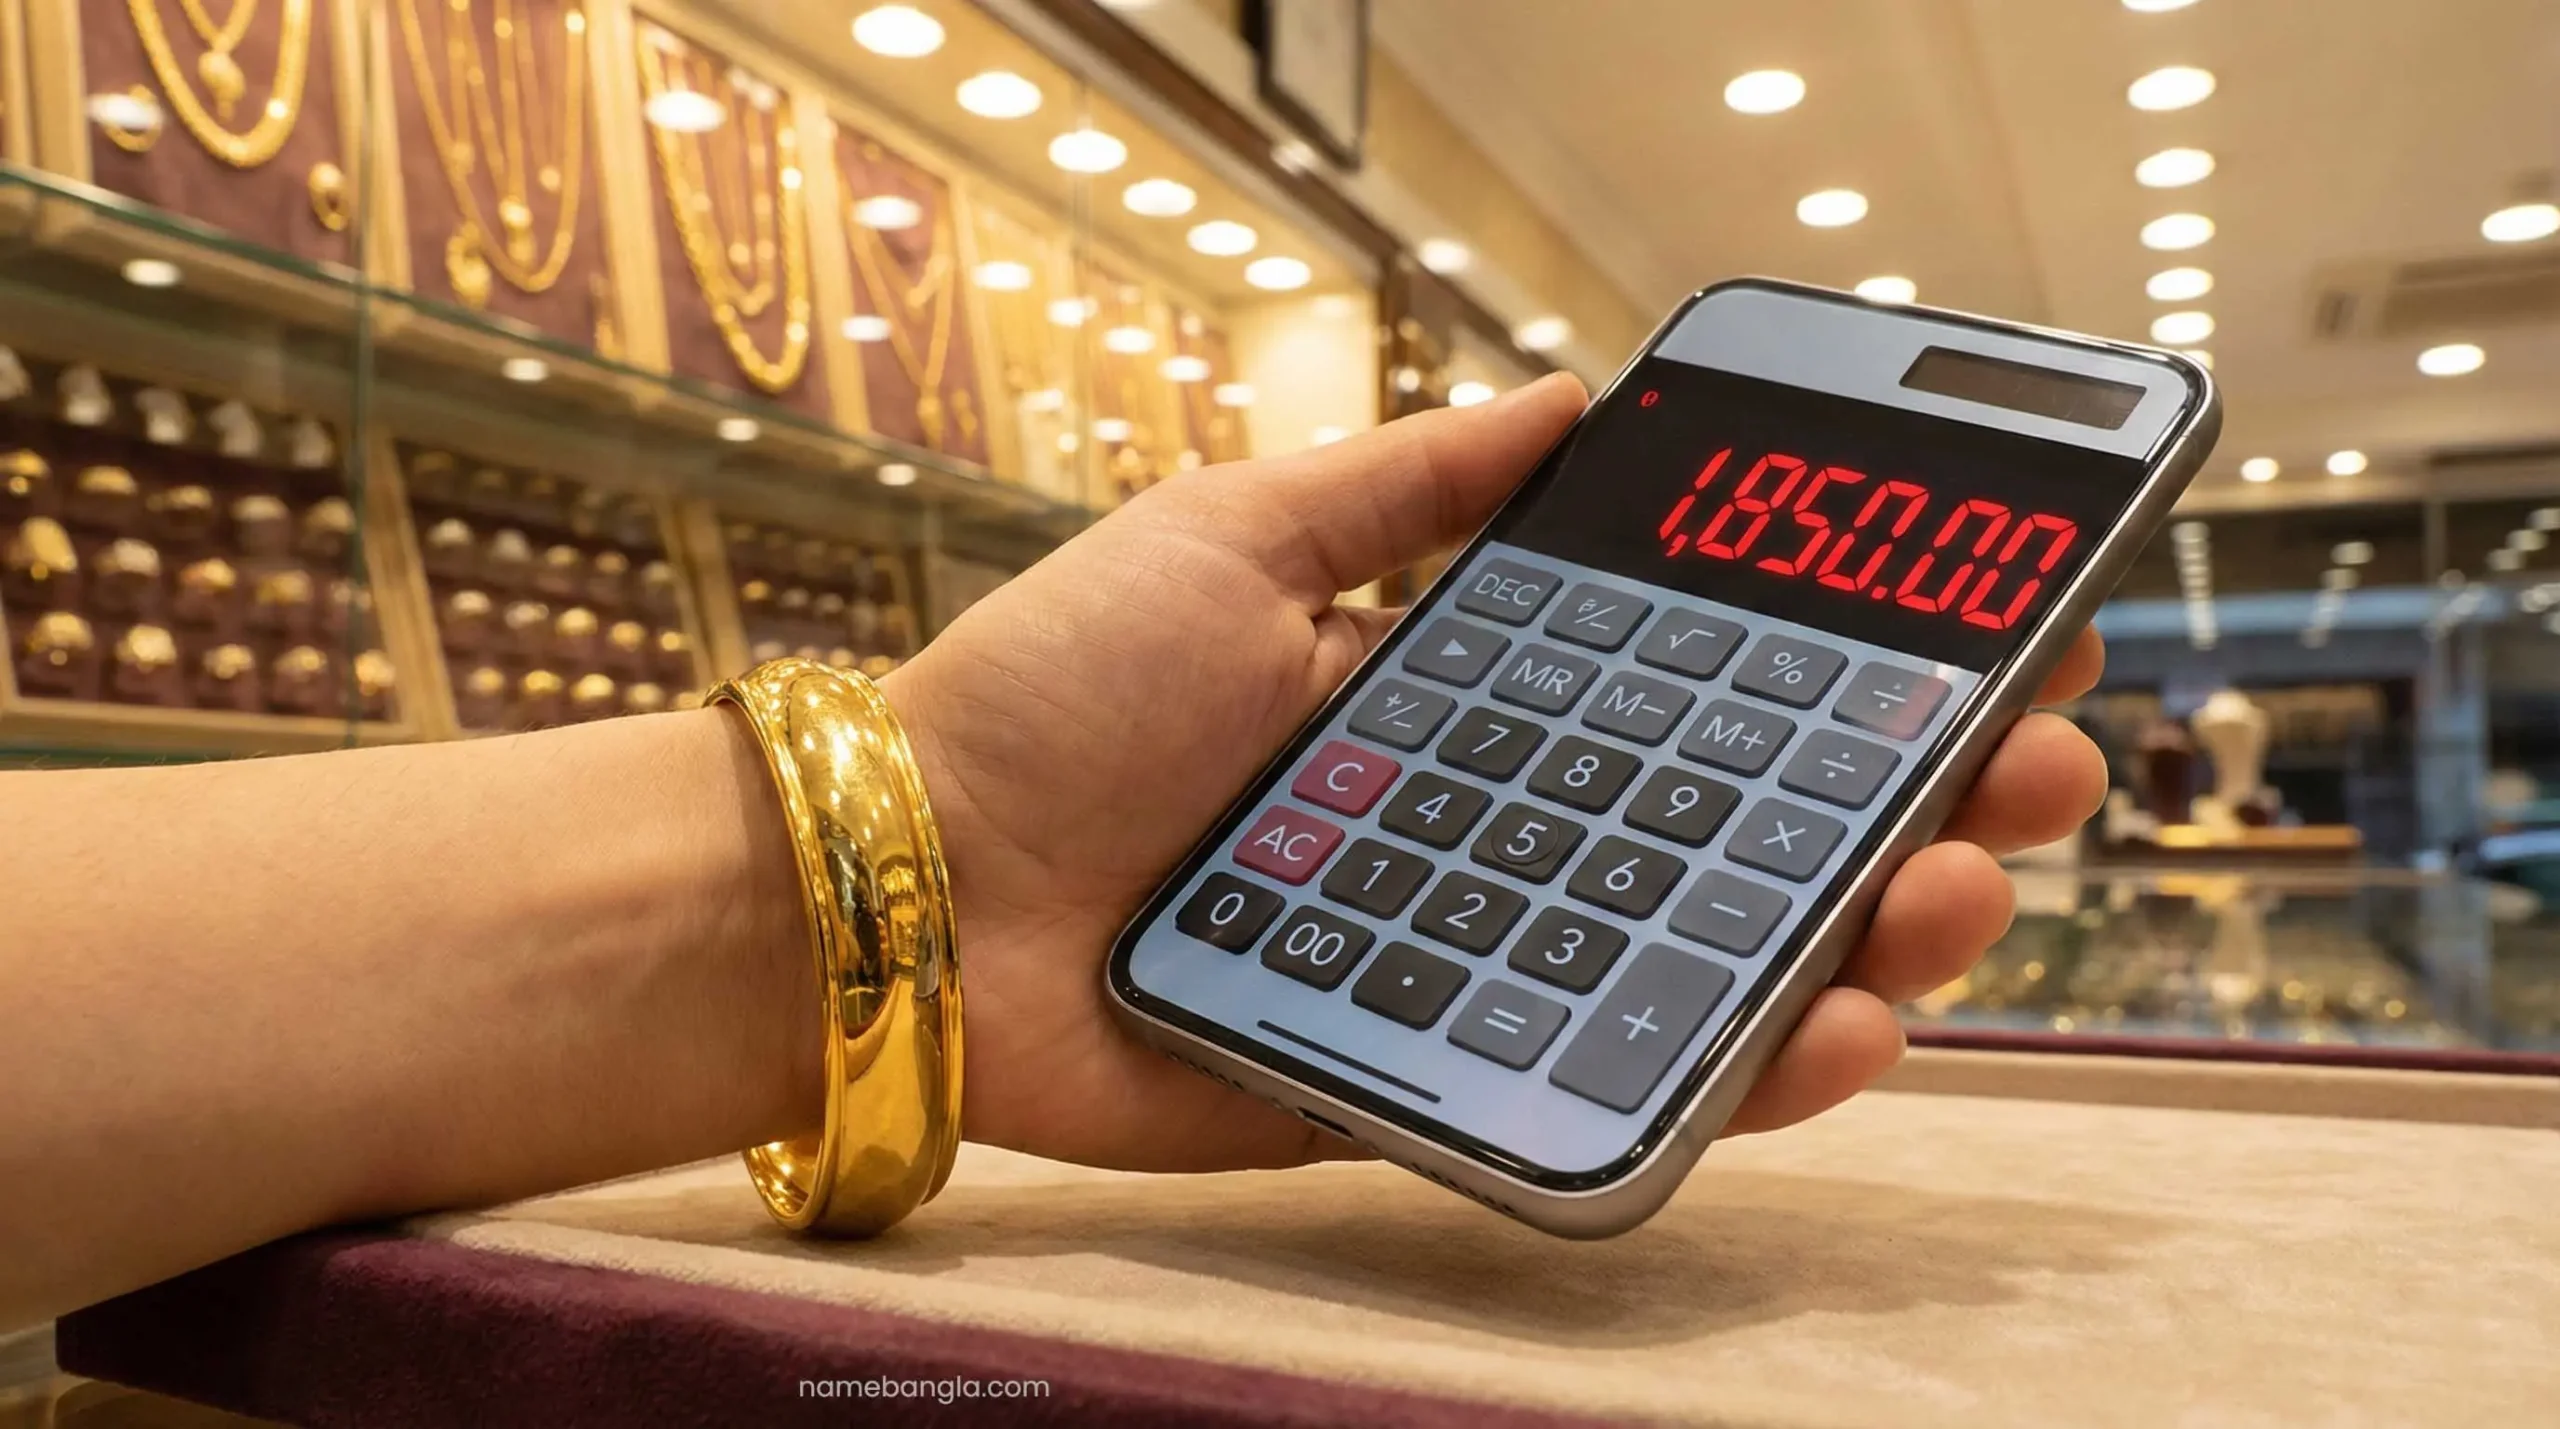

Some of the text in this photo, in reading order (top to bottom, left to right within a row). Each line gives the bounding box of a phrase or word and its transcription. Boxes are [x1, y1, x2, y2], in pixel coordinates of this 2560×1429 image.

[1660, 449, 2077, 630] 1,850.00
[1475, 573, 1541, 607] DEC
[1512, 657, 1574, 695] MR
[1769, 652, 1808, 684] %
[1471, 724, 1510, 754] 7
[1701, 715, 1766, 751] M+
[1327, 762, 1365, 792] C
[1563, 755, 1600, 787] 8
[1416, 793, 1451, 825] 4
[1665, 786, 1700, 817] 9
[1254, 824, 1317, 862] AC
[1506, 821, 1548, 857] 5
[1362, 859, 1390, 891] 1
[1605, 857, 1641, 891] 6
[1209, 892, 1246, 927] 0
[1445, 893, 1487, 930] 2
[1285, 921, 1345, 965] 00
[1544, 928, 1585, 965] 3
[1622, 1006, 1659, 1041] +
